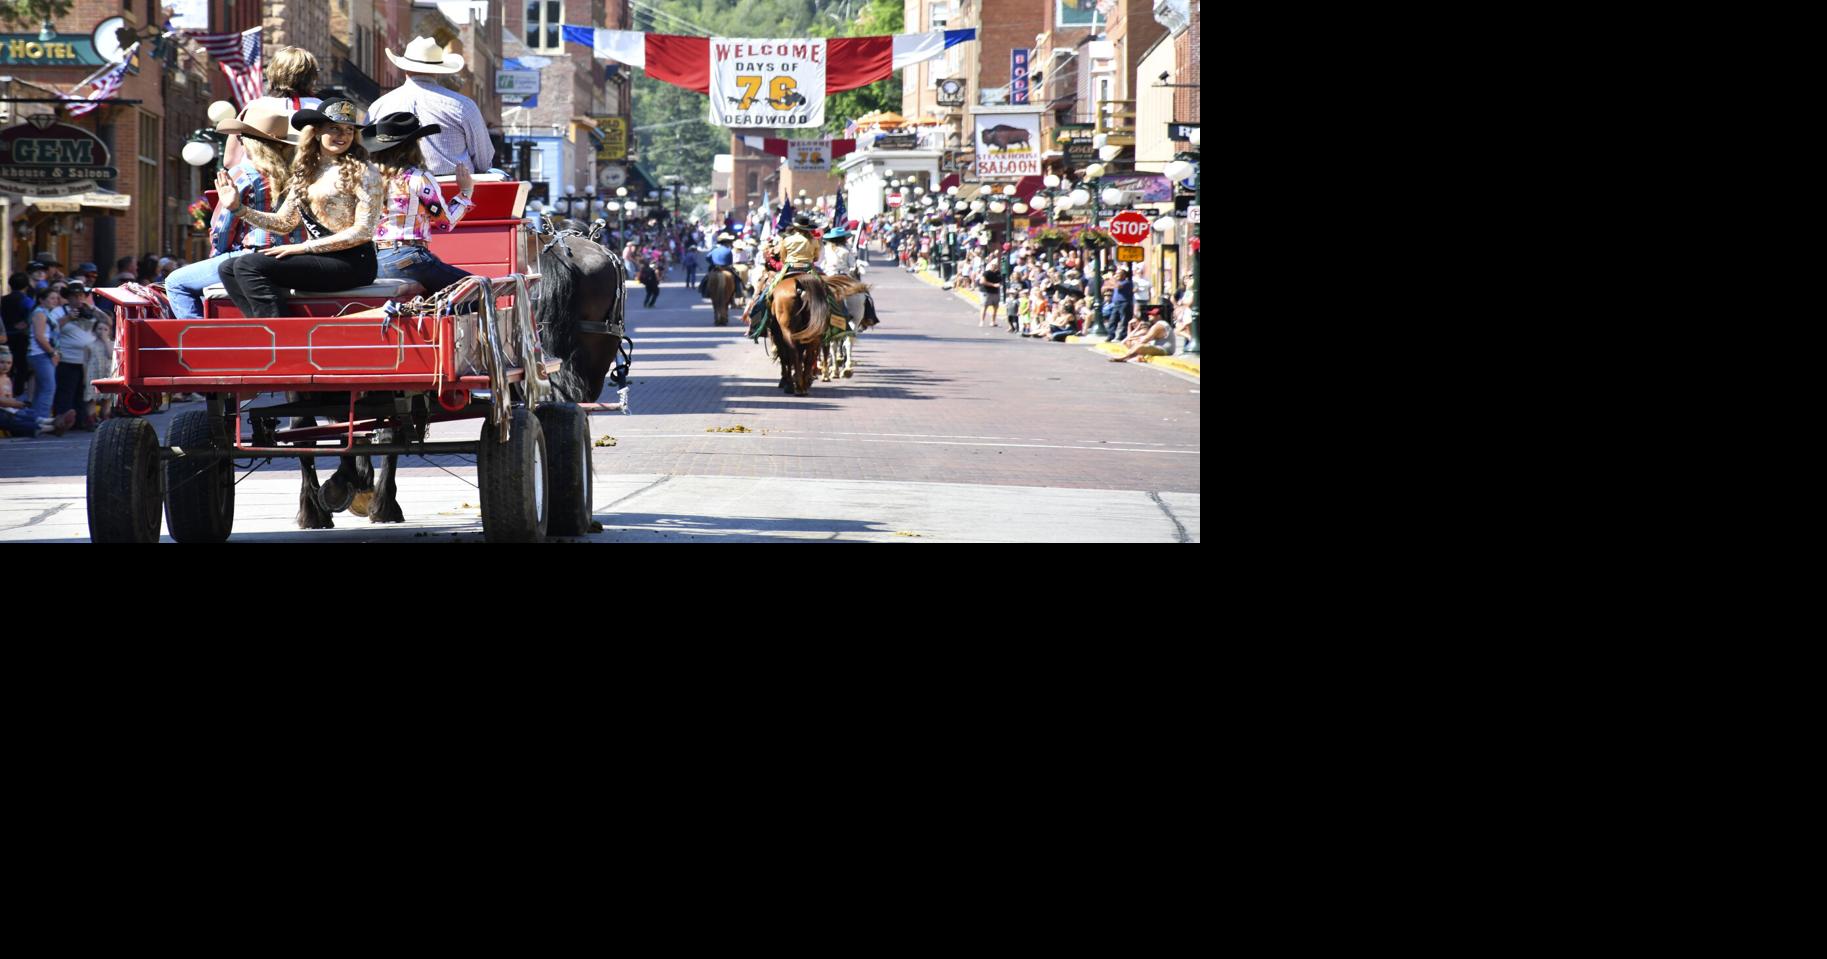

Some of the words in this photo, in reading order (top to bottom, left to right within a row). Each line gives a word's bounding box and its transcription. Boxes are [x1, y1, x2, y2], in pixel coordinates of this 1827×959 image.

[9, 39, 76, 59] HOTEL
[715, 43, 821, 63] WELCOME
[735, 62, 775, 72] DAYS
[781, 62, 799, 72] OF
[735, 75, 798, 111] 76
[724, 114, 808, 125] DEADWOOD
[13, 138, 94, 164] GEM
[52, 168, 63, 177] &
[69, 168, 110, 178] Saloon
[978, 161, 1037, 174] SALOON
[1111, 222, 1148, 235] STOP
